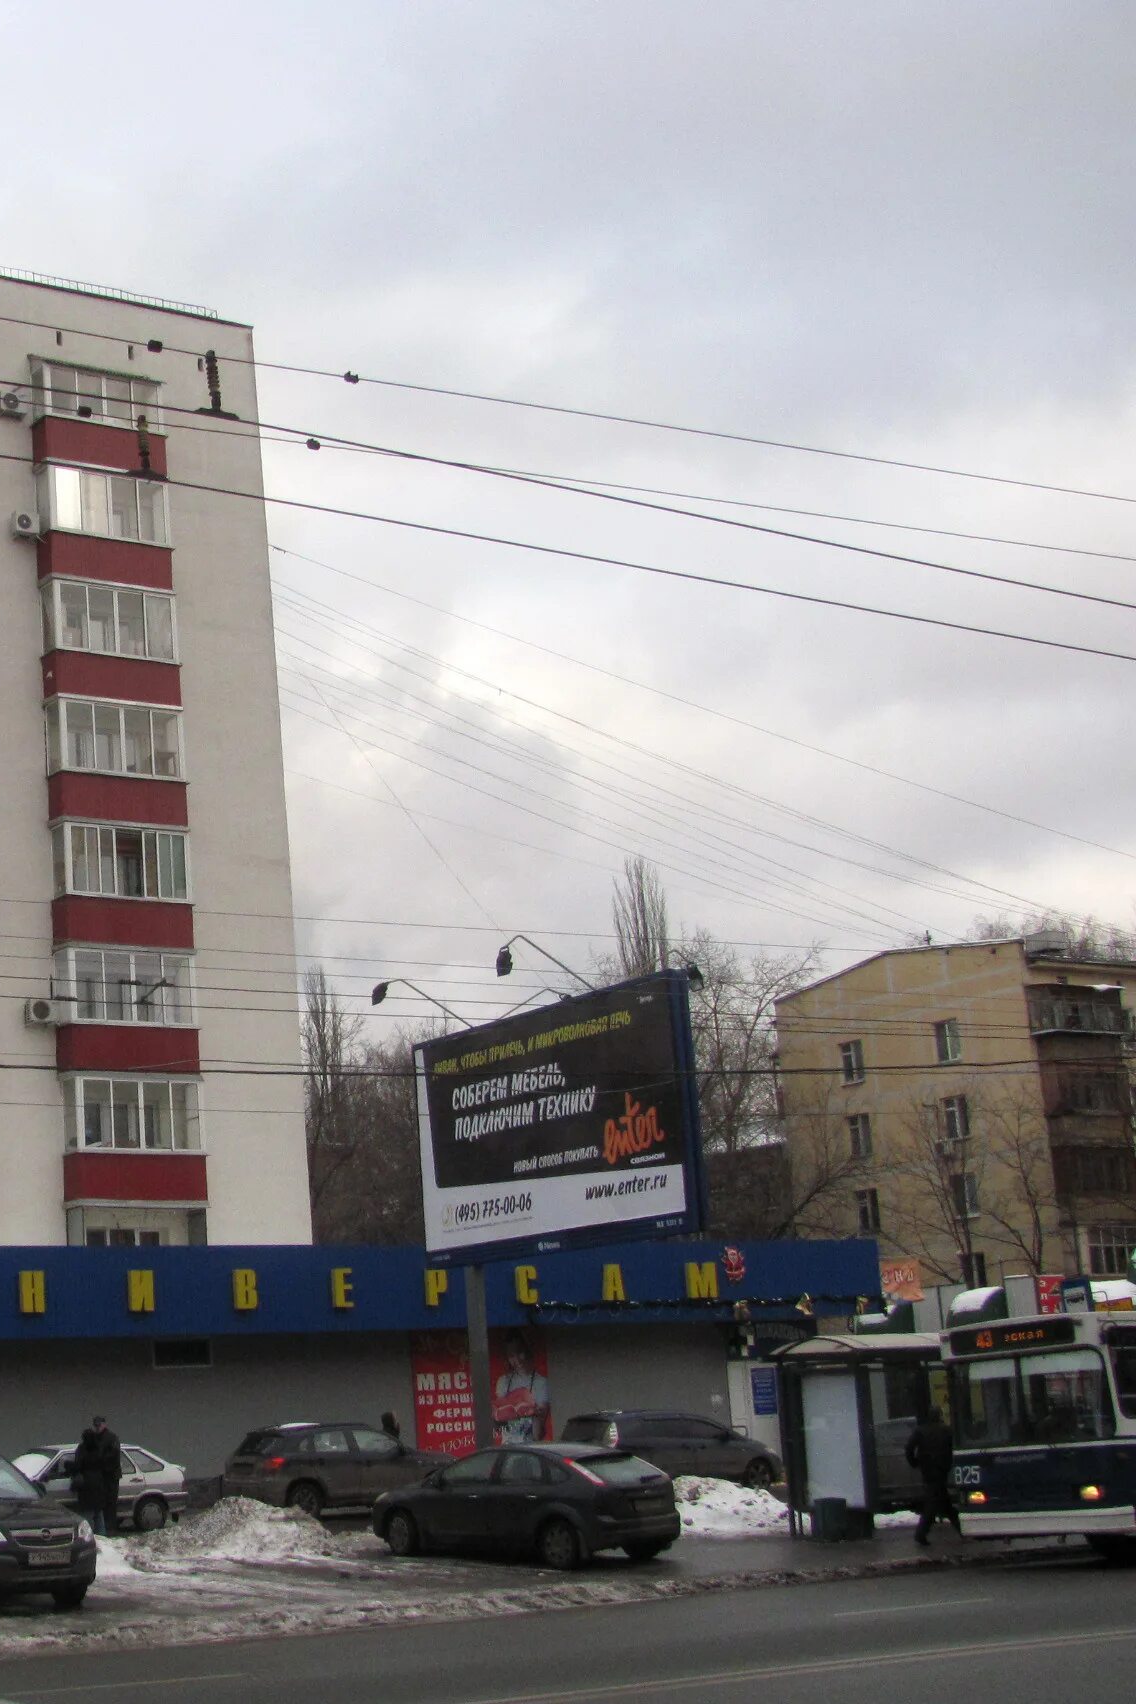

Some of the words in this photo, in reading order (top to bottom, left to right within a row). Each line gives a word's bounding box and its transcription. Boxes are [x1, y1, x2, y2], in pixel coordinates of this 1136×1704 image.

[452, 1075, 508, 1111] СОБЕРЕМ
[511, 1062, 566, 1095] МЕБЕЛЬ,
[454, 1101, 534, 1142] ПОДКЛЮЧИМ
[537, 1084, 597, 1122] ТЕХНИКУ
[513, 1157, 537, 1174] НОВЫЙ
[538, 1152, 564, 1170] СПОСОБ
[564, 1145, 599, 1164] ПОКУПАТЬ
[584, 1173, 668, 1201] www.enter.ru
[454, 1203, 480, 1226] (495)
[481, 1192, 533, 1220] 775-00-06
[416, 1371, 473, 1391] МЯС
[437, 1392, 474, 1404] ЛУЧШ
